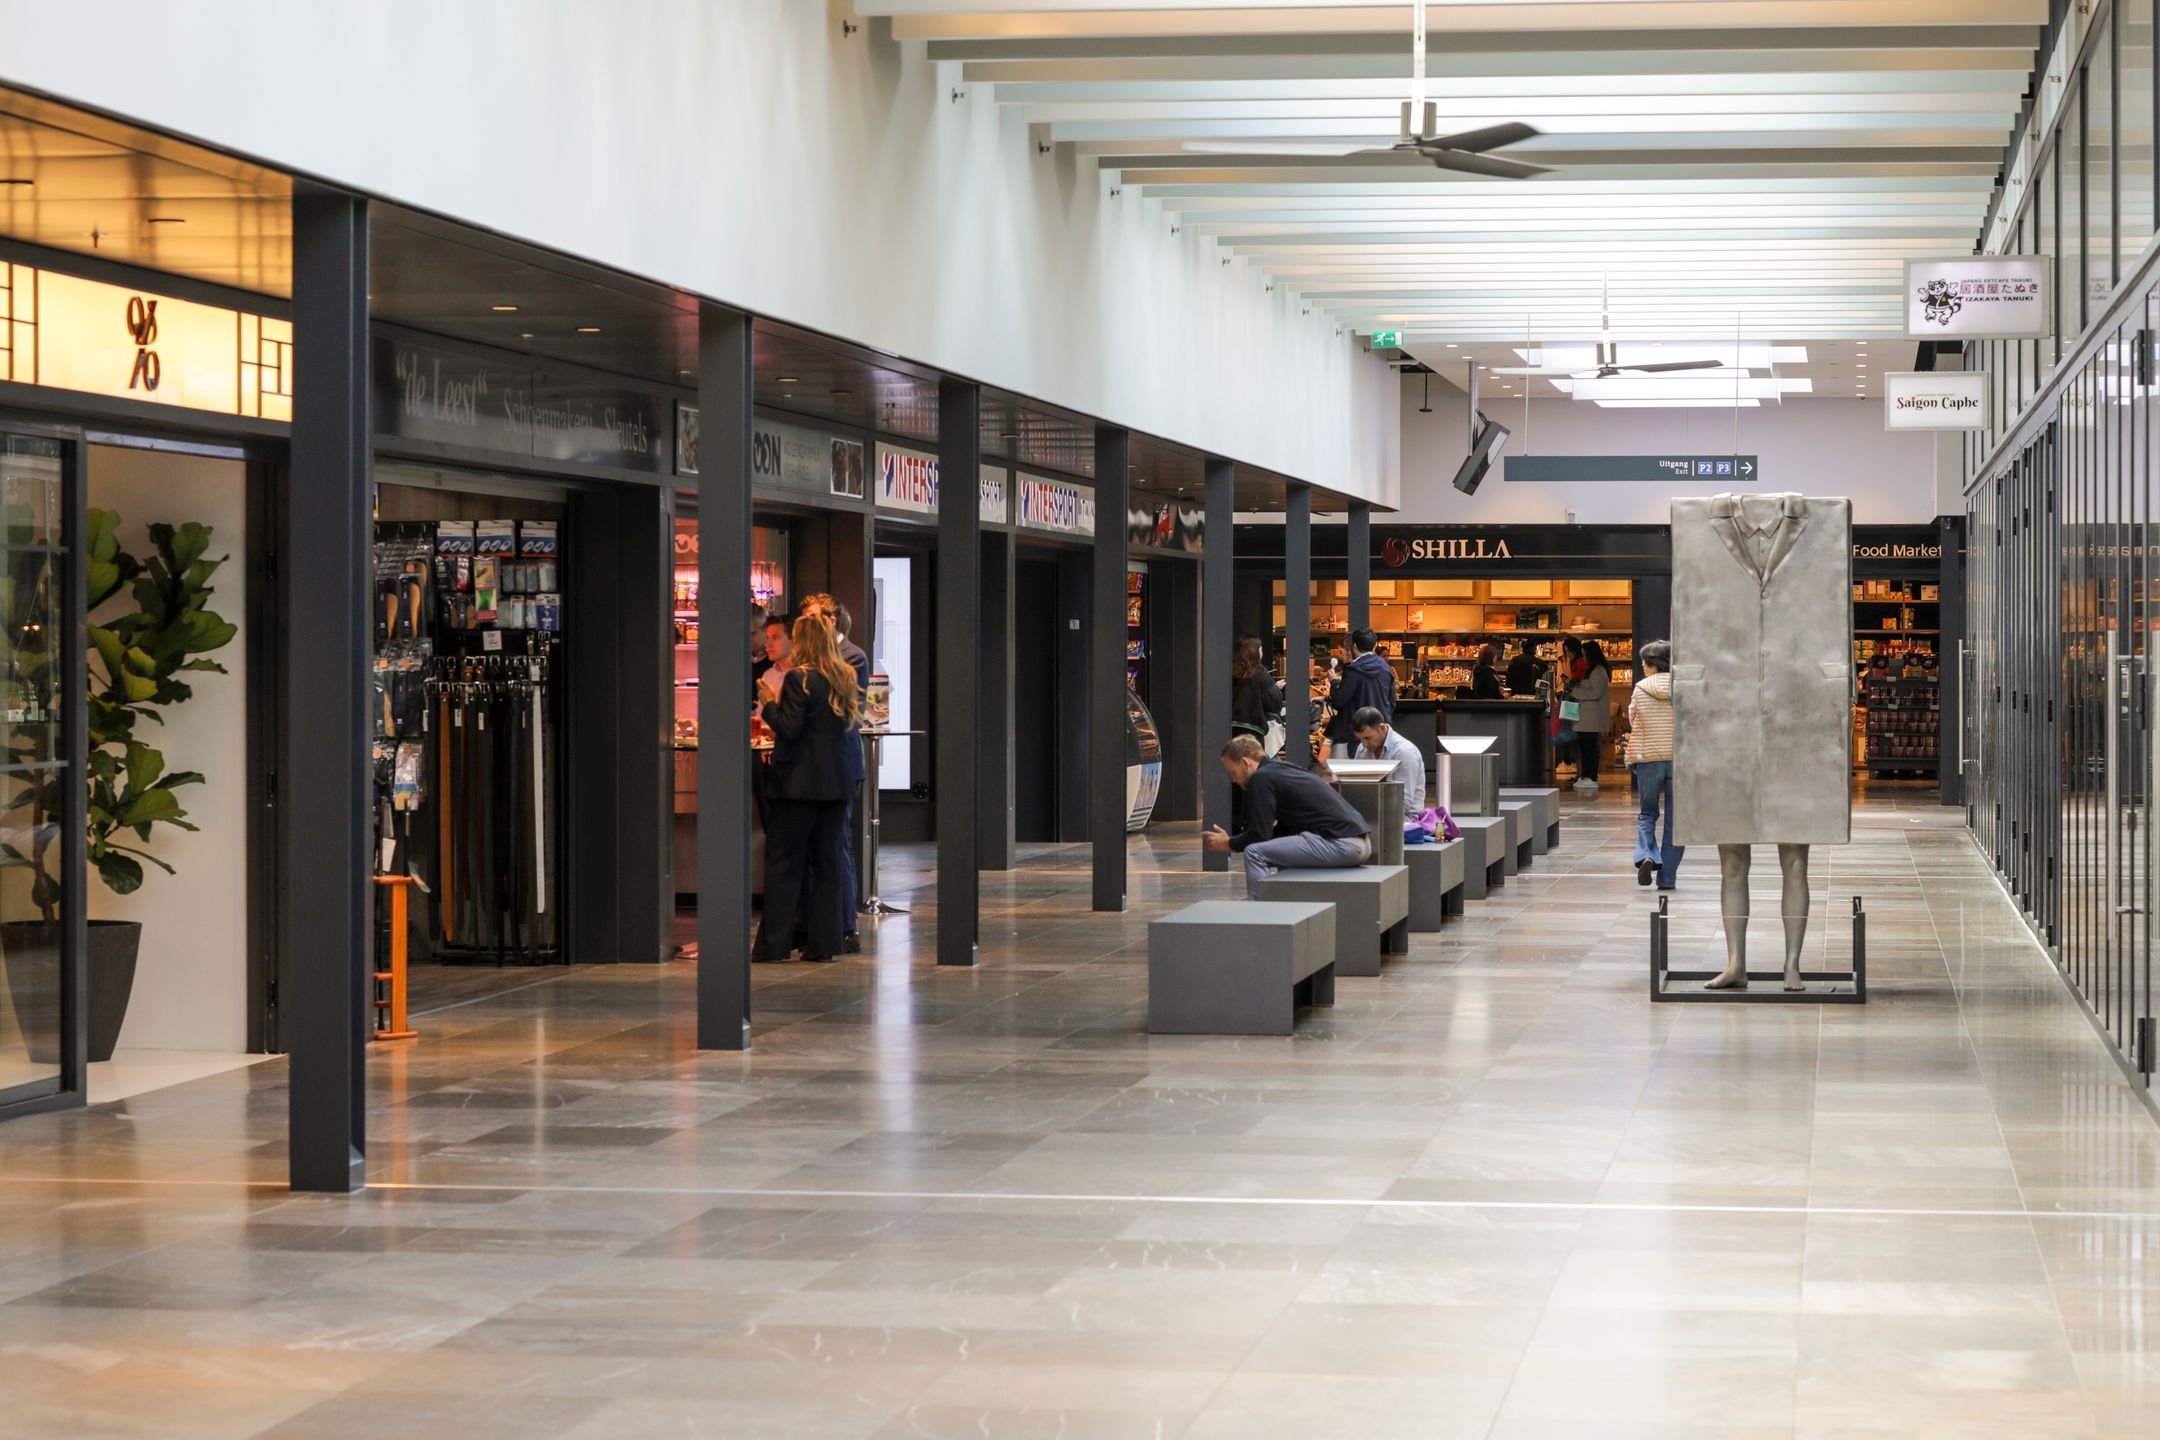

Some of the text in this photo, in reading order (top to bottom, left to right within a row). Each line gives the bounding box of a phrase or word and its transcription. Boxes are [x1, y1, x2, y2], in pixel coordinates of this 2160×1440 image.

[1960, 283, 2039, 294] 居酒屋たぬき
[1896, 396, 1979, 410] Saigon Caphe
[604, 406, 648, 453] Sleutels
[1659, 460, 1689, 469] Uitgang
[1700, 463, 1731, 473] P2 P3
[893, 453, 939, 507] INTERSP
[1028, 480, 1078, 529] INTERSPORT
[1411, 538, 1512, 559] SHILLA
[1852, 544, 1942, 557] Food Market
